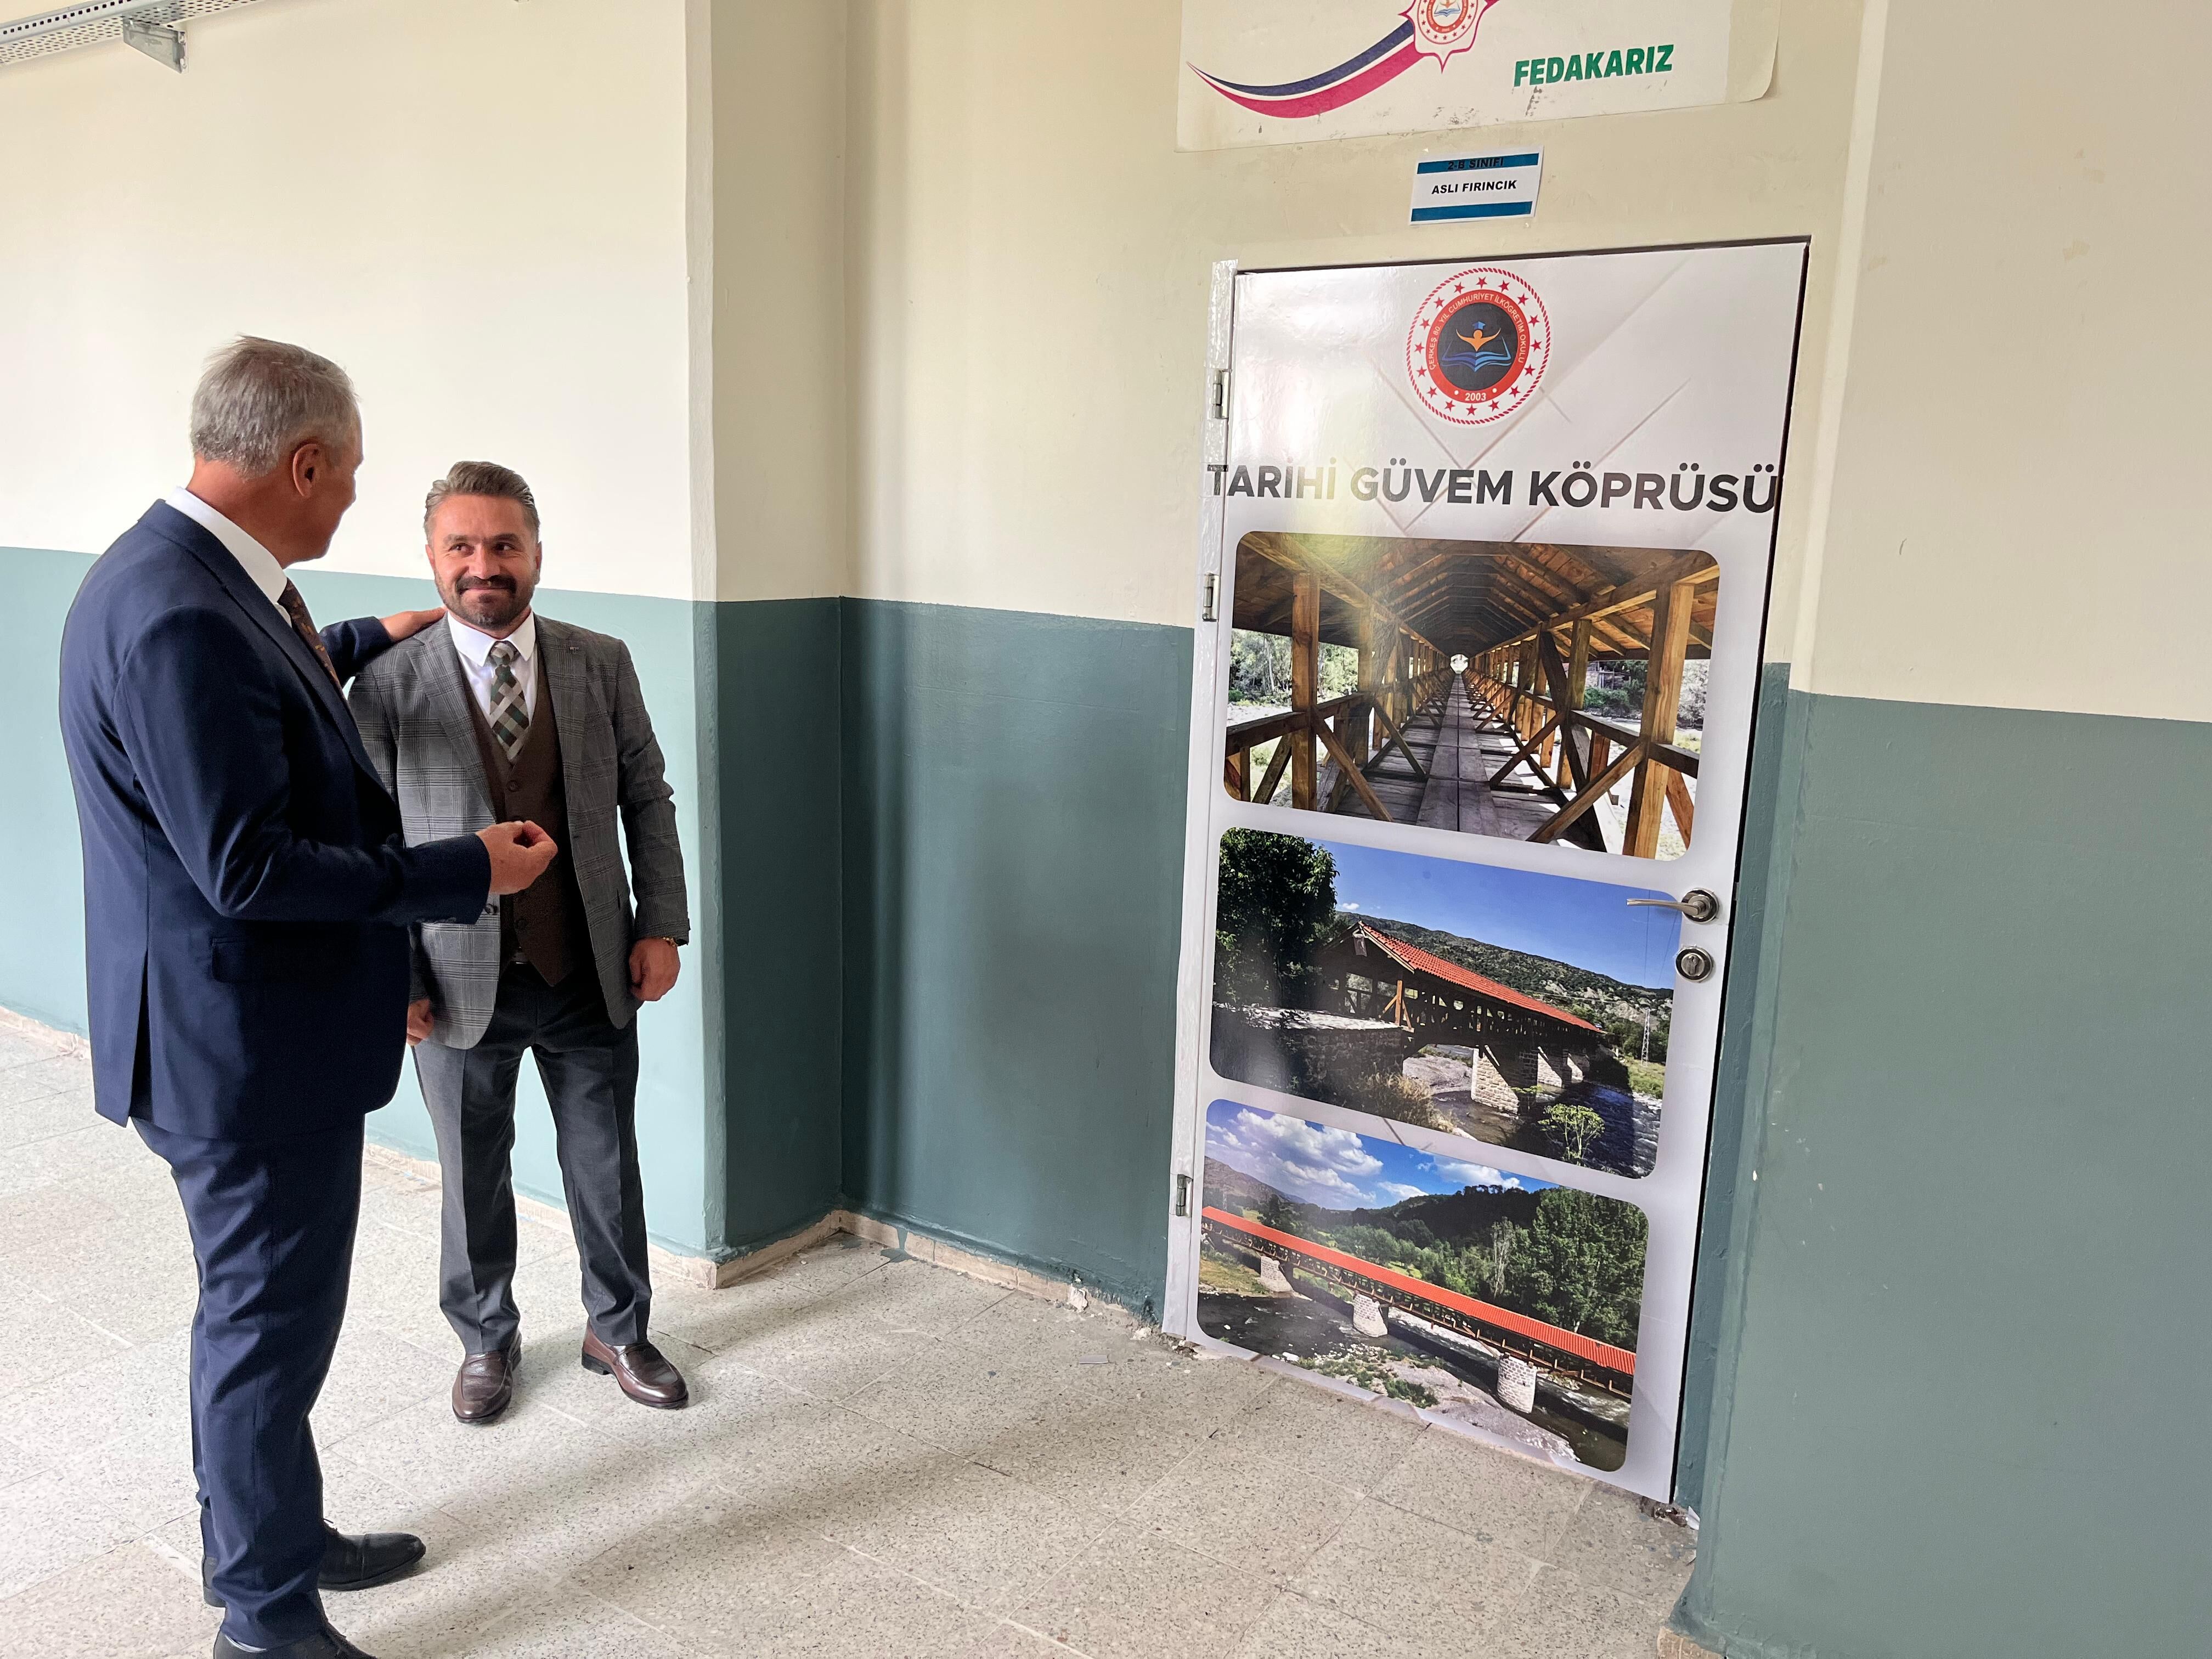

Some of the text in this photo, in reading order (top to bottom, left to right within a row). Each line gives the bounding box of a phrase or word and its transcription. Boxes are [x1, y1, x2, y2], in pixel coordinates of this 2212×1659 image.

[1514, 44, 1674, 87] FEDAKARIZ
[1447, 157, 1504, 170] 2-B SINIFI
[1431, 180, 1517, 194] ASLI FIRINCIK
[1429, 337, 1437, 370] ÇERKEŞ
[1433, 326, 1442, 336] 80.
[1438, 313, 1450, 323] YIL
[1448, 292, 1494, 313] CUMHURİYET
[1517, 334, 1526, 363] OKULU
[1465, 392, 1486, 401] 2003
[1207, 456, 1778, 514] TARİHİ GÜVEM KÖPRÜSÜ
